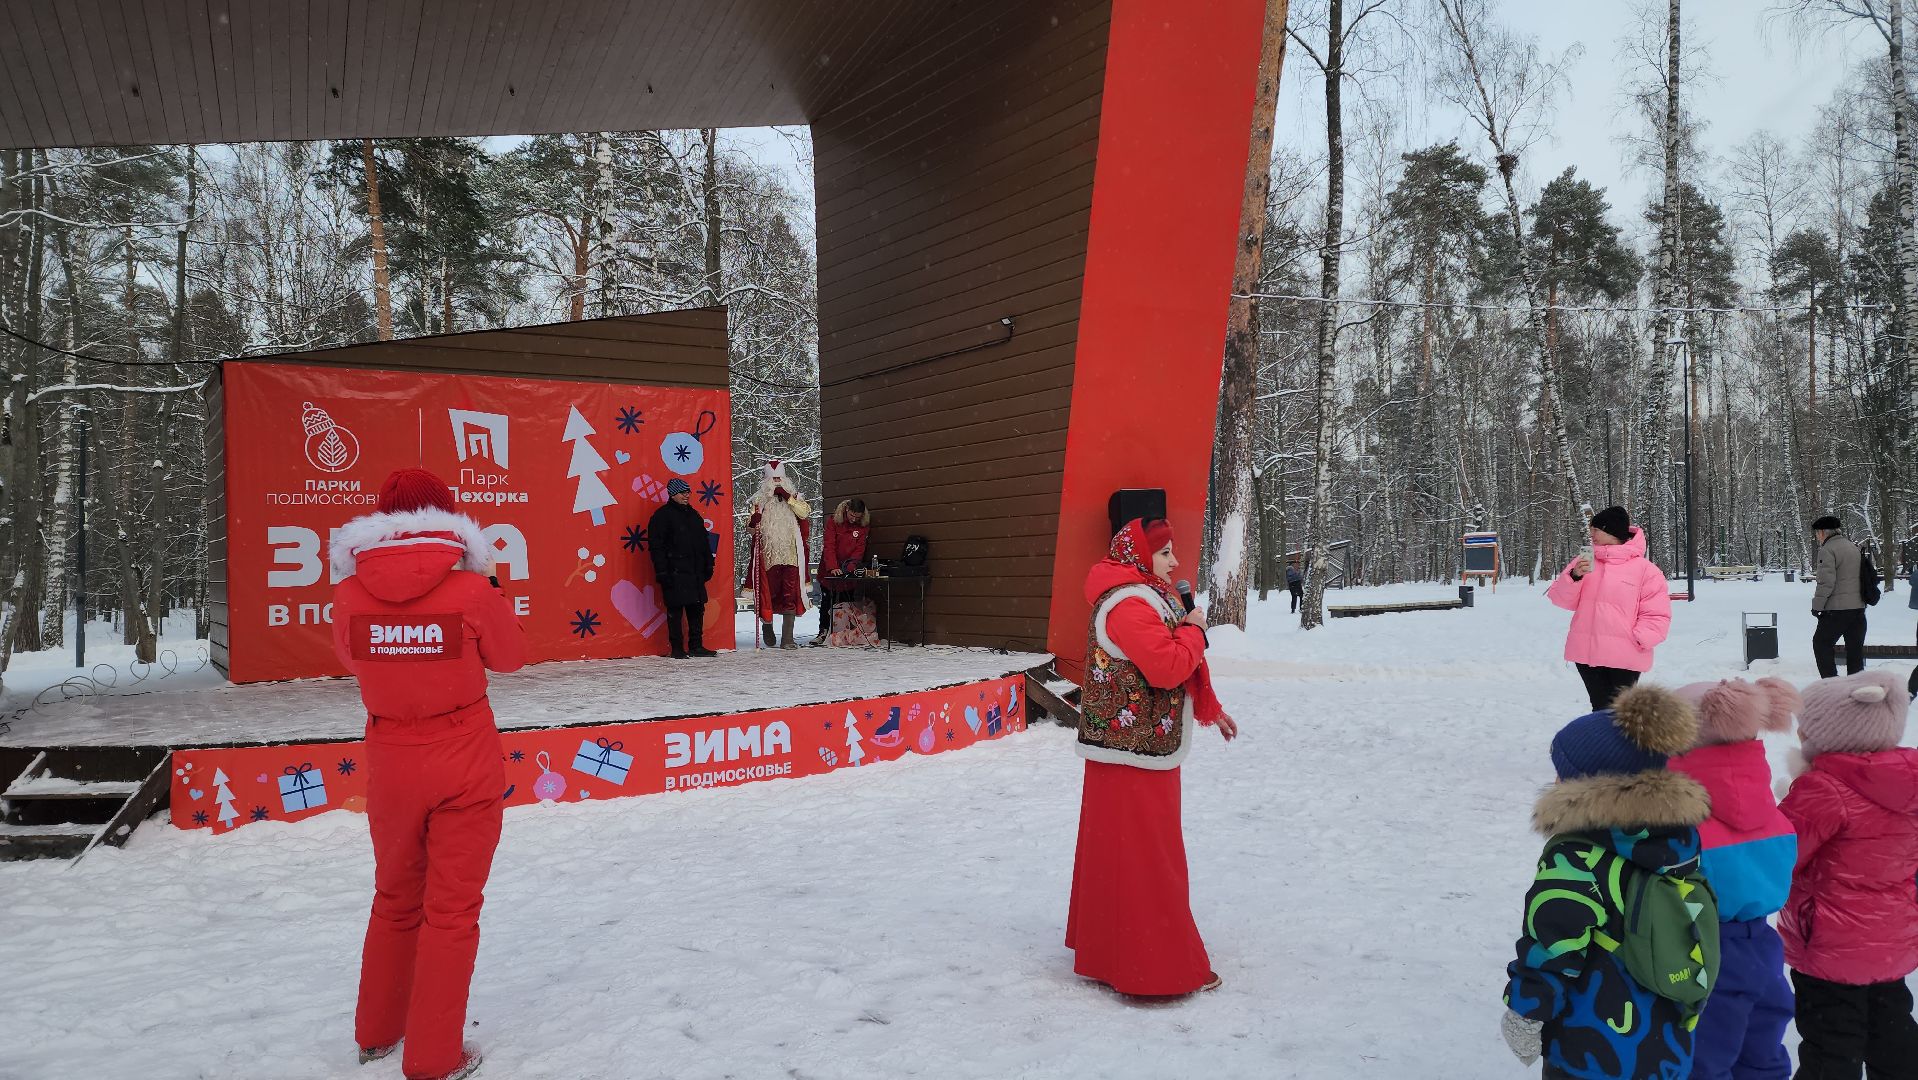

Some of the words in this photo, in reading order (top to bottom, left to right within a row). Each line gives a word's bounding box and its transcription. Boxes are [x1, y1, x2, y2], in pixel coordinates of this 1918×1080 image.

[305, 480, 361, 491] ПАРКИ
[460, 468, 509, 489] Парк
[266, 493, 380, 505] ПОДМОСКОВ
[268, 604, 290, 627] В
[369, 623, 444, 644] ЗИМА
[370, 646, 376, 654] В
[377, 645, 444, 656] ПОДМОСКОВЬЕ
[664, 720, 792, 769] ЗИМА
[665, 776, 676, 790] В
[679, 761, 792, 788] ПОДМОСКОВЬЕ
